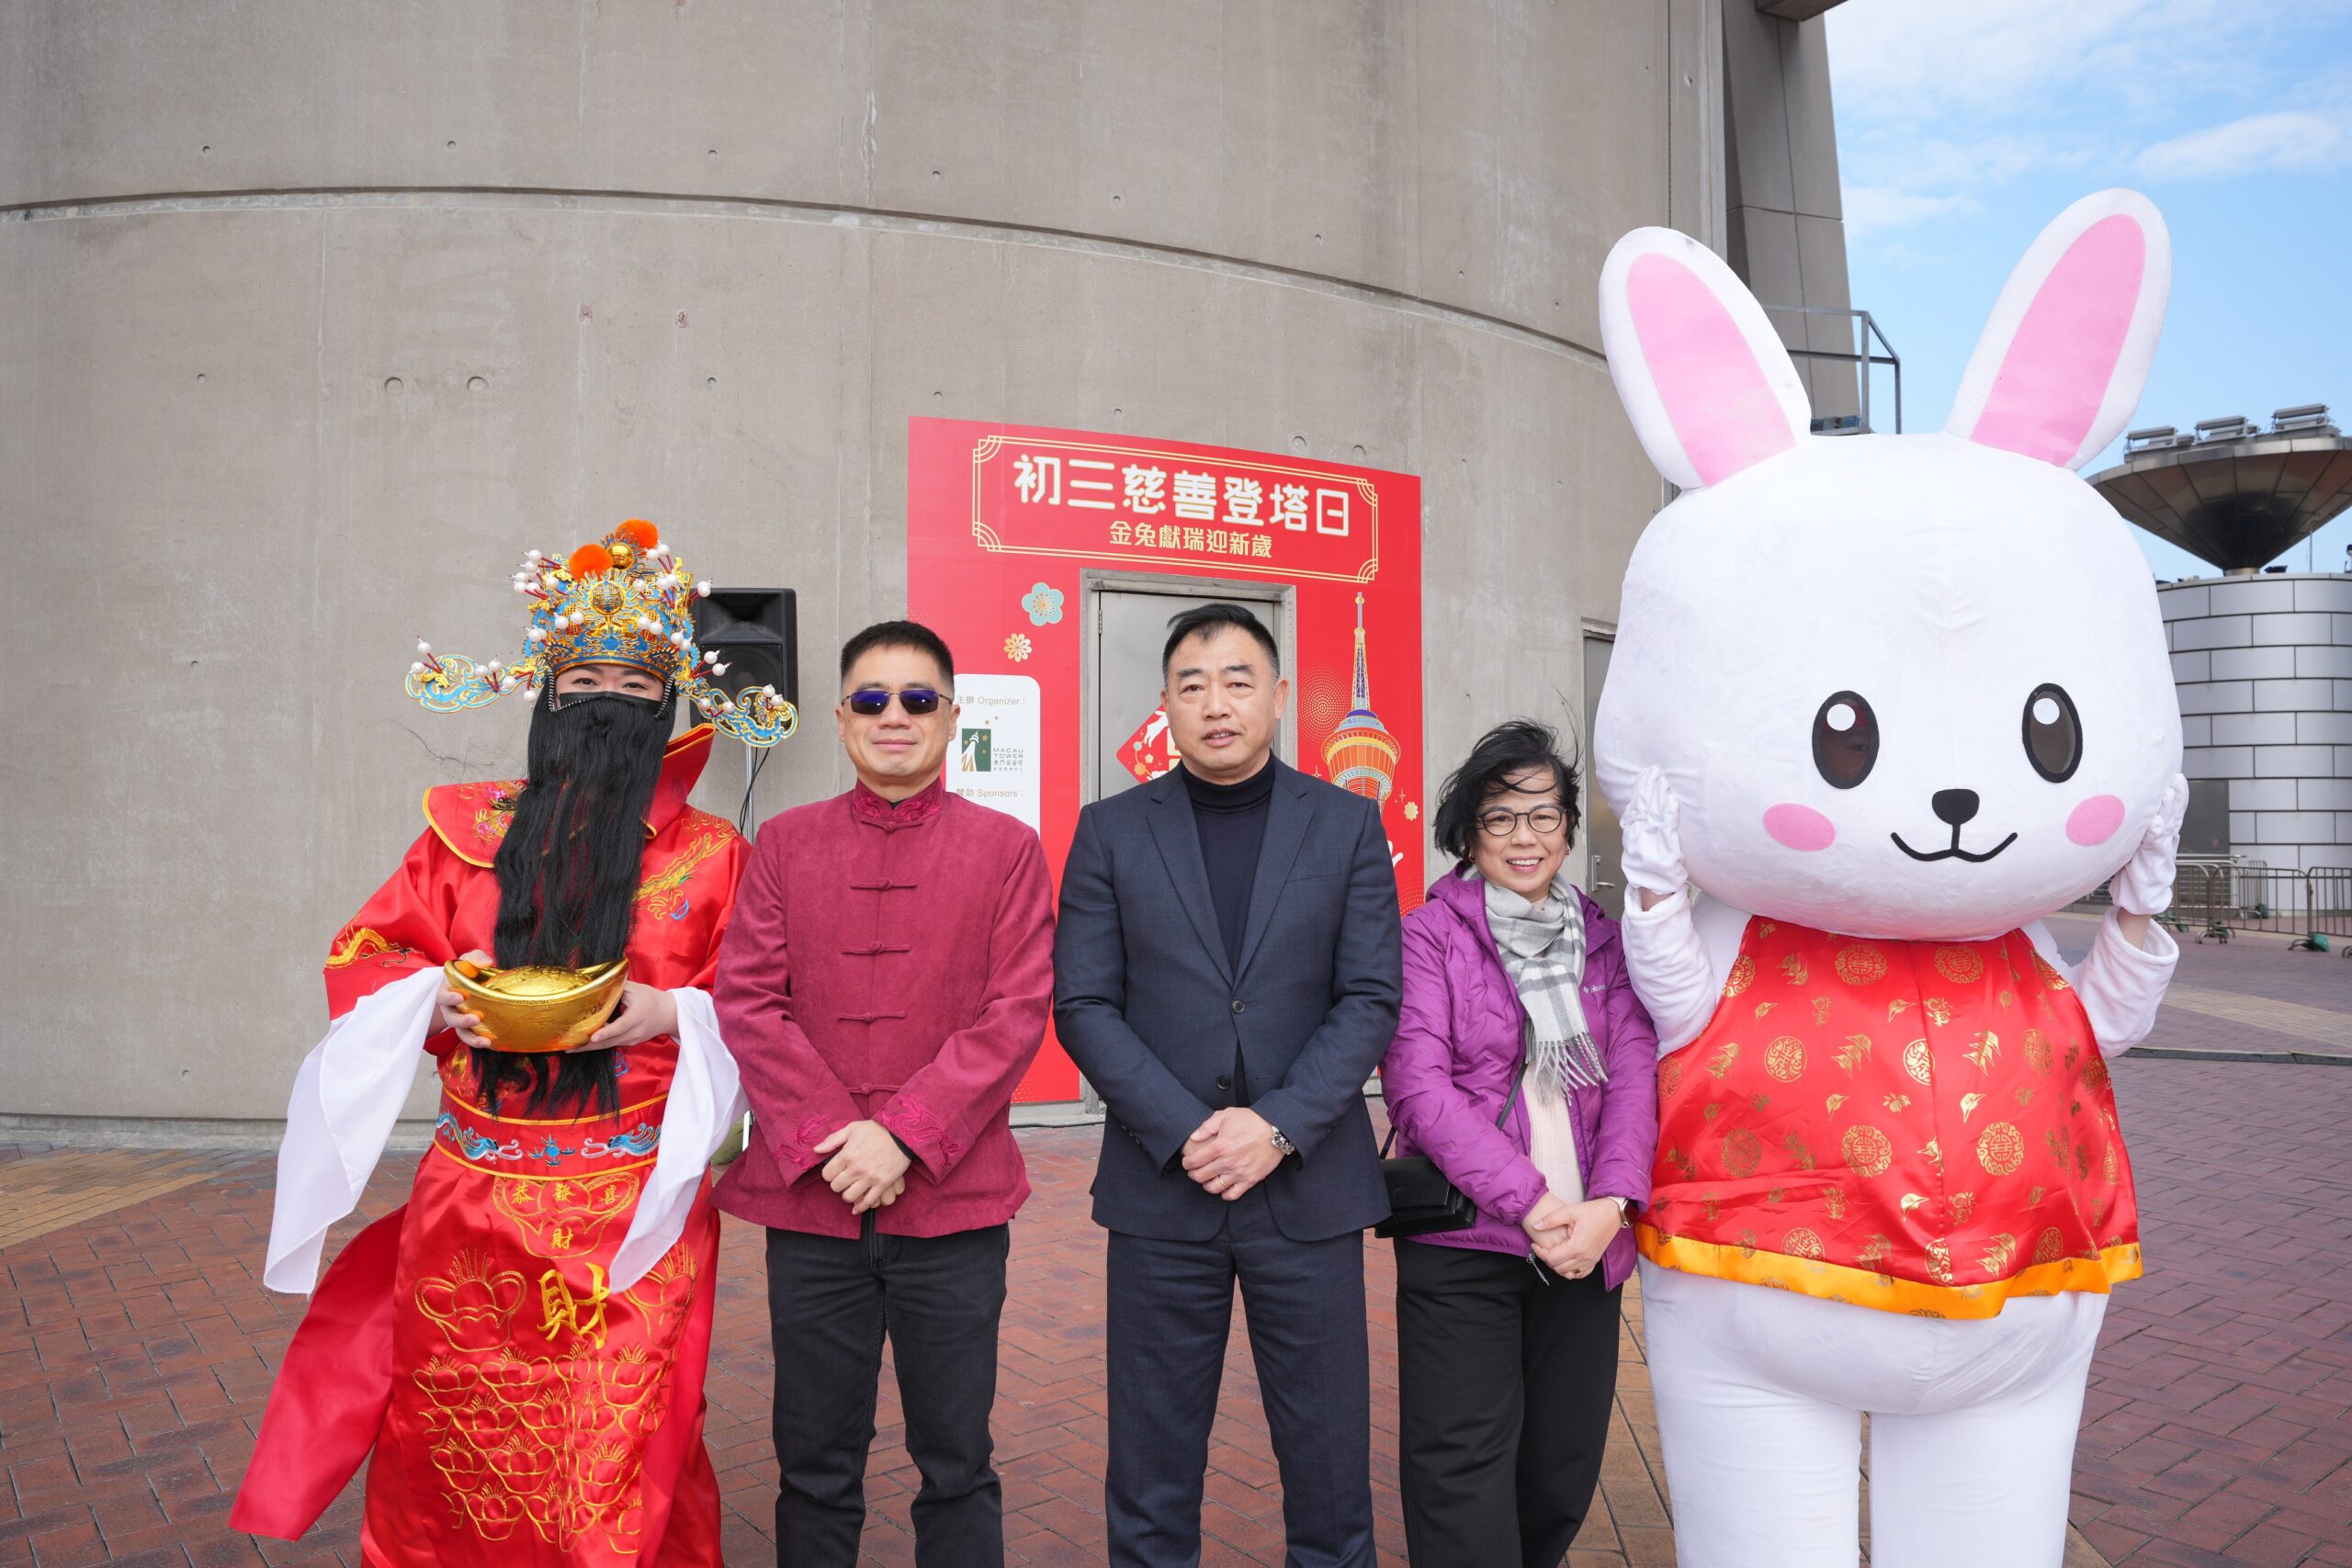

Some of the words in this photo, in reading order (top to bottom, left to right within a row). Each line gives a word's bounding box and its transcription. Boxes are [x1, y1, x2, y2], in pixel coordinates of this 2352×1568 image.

[1013, 455, 1349, 536] 初三慈善登塔日
[1109, 520, 1272, 558] 金兔獻瑞迎新歲
